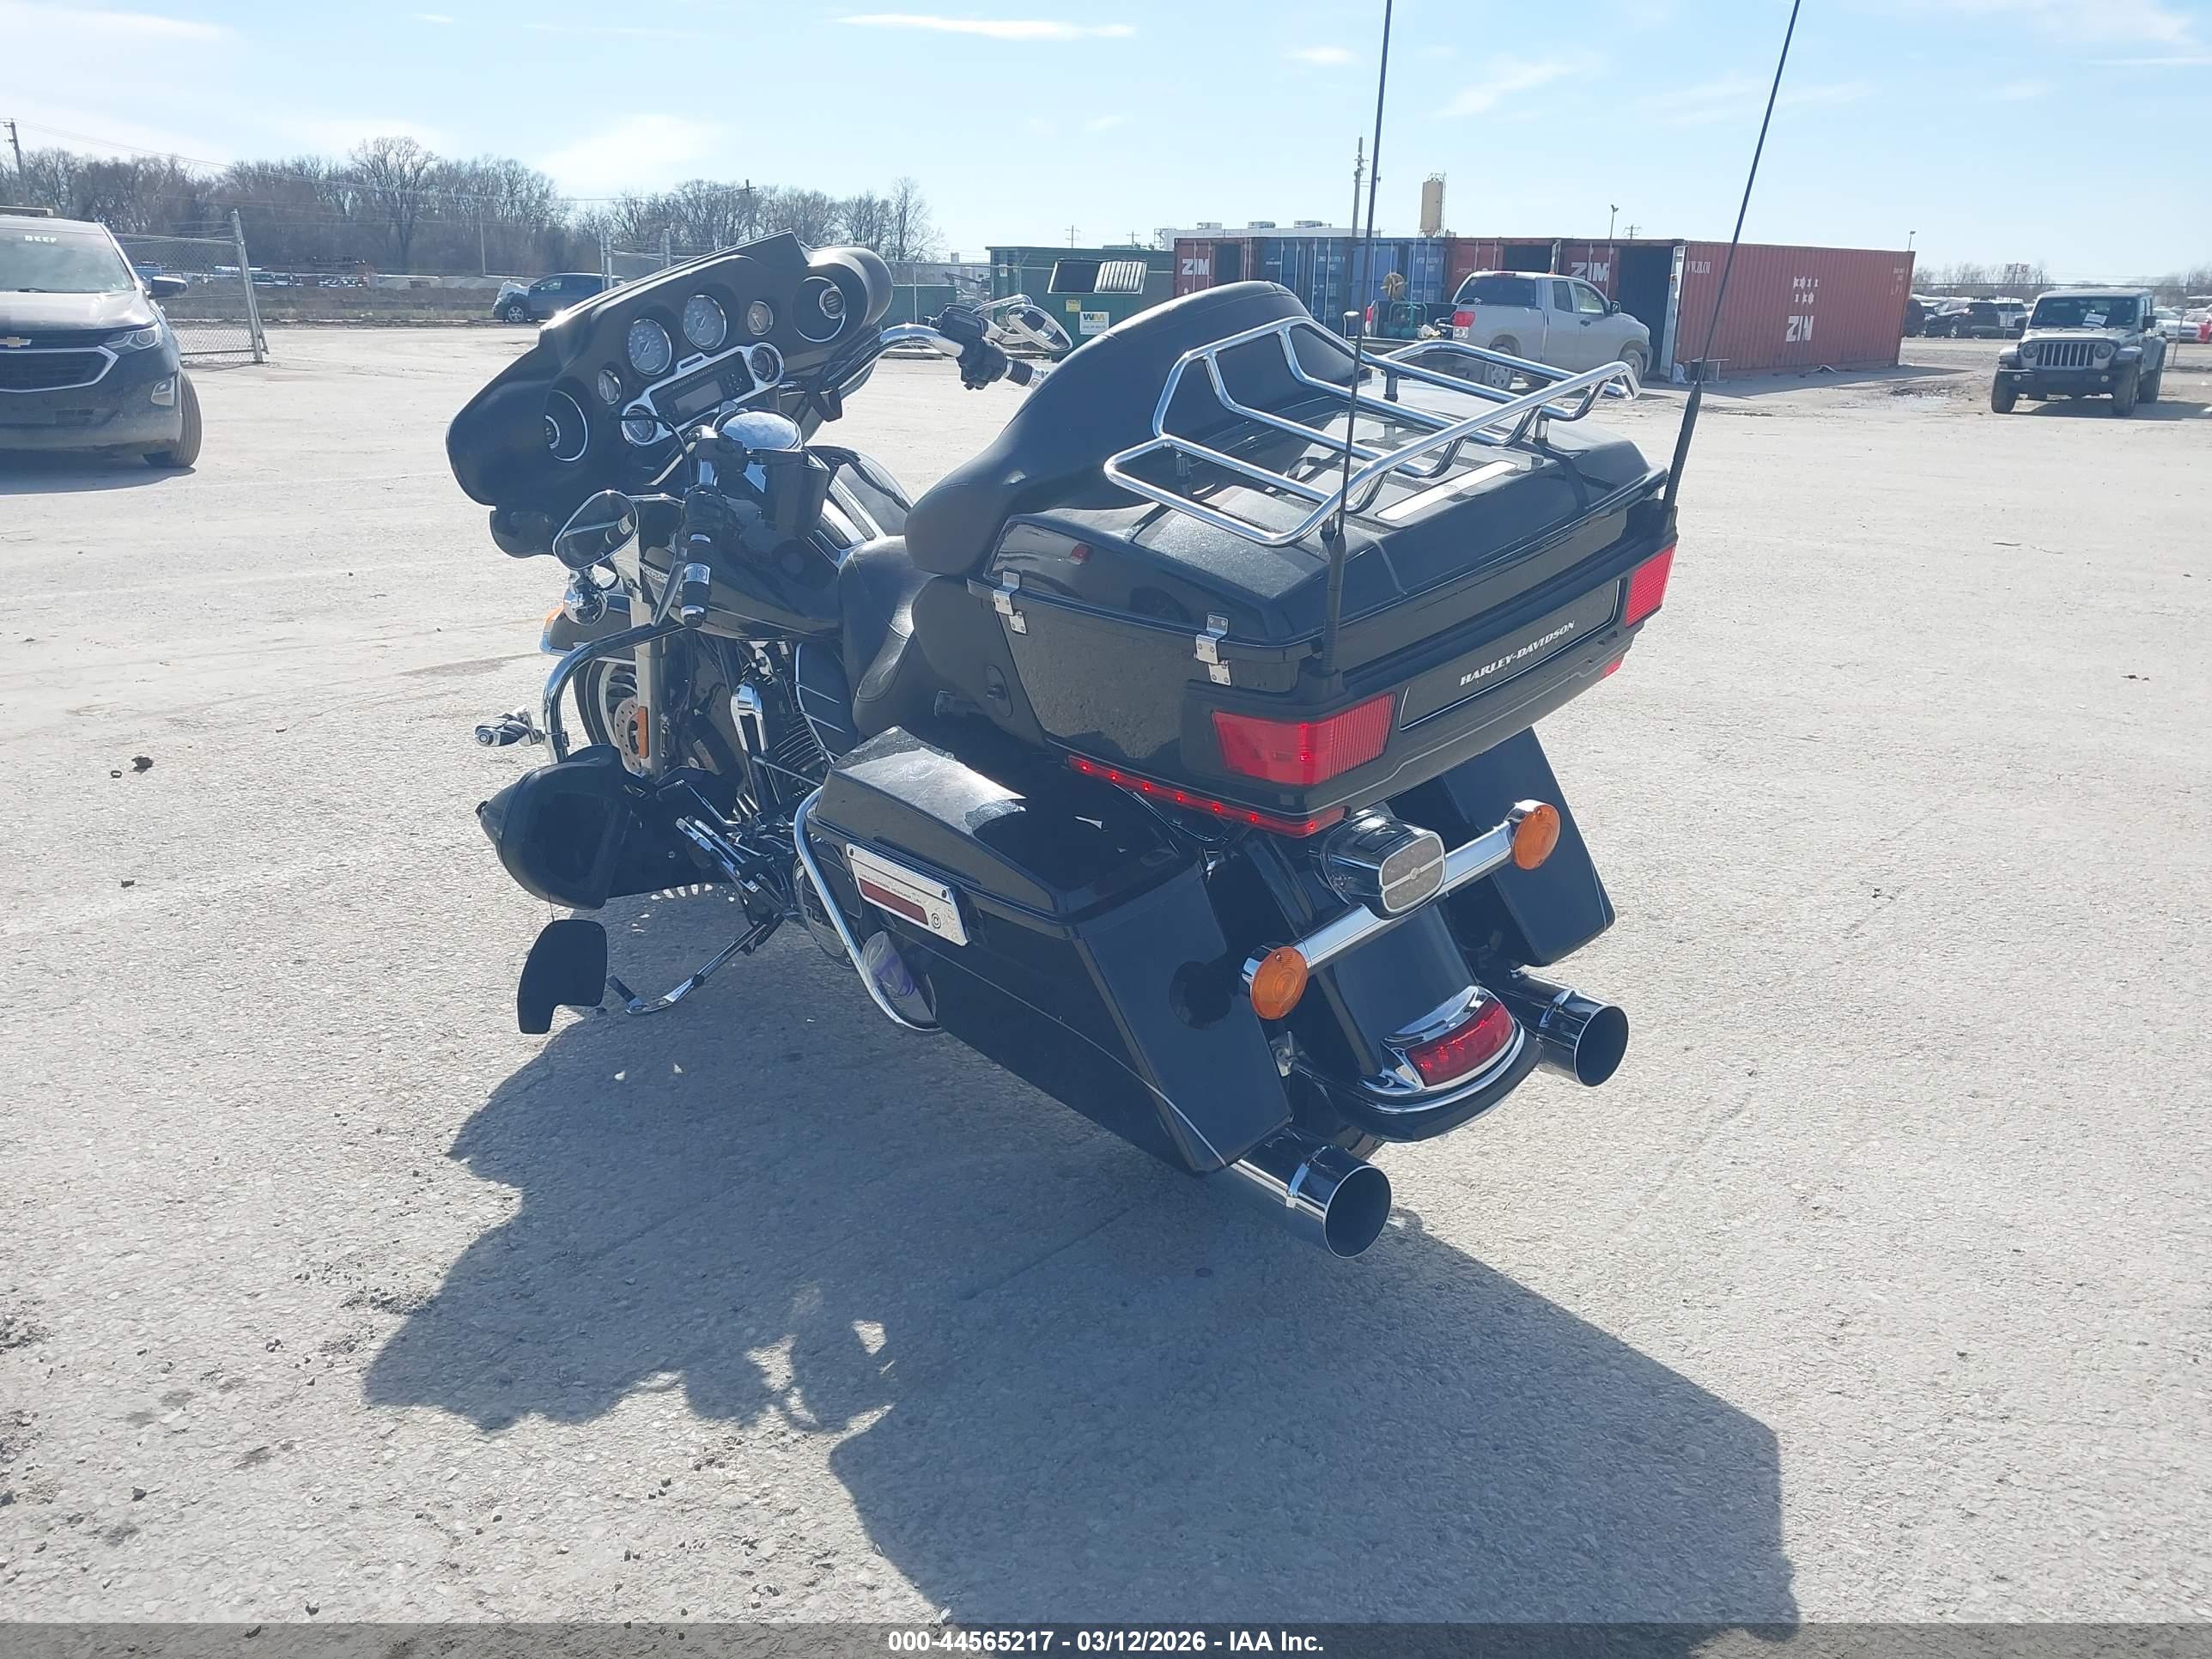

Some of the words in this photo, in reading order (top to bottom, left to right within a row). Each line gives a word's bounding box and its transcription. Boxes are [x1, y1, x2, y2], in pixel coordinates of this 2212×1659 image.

[1182, 258, 1210, 276] ZIM
[1570, 261, 1609, 282] ZIM
[1460, 620, 1576, 687] HARLEY-DAVIDSON
